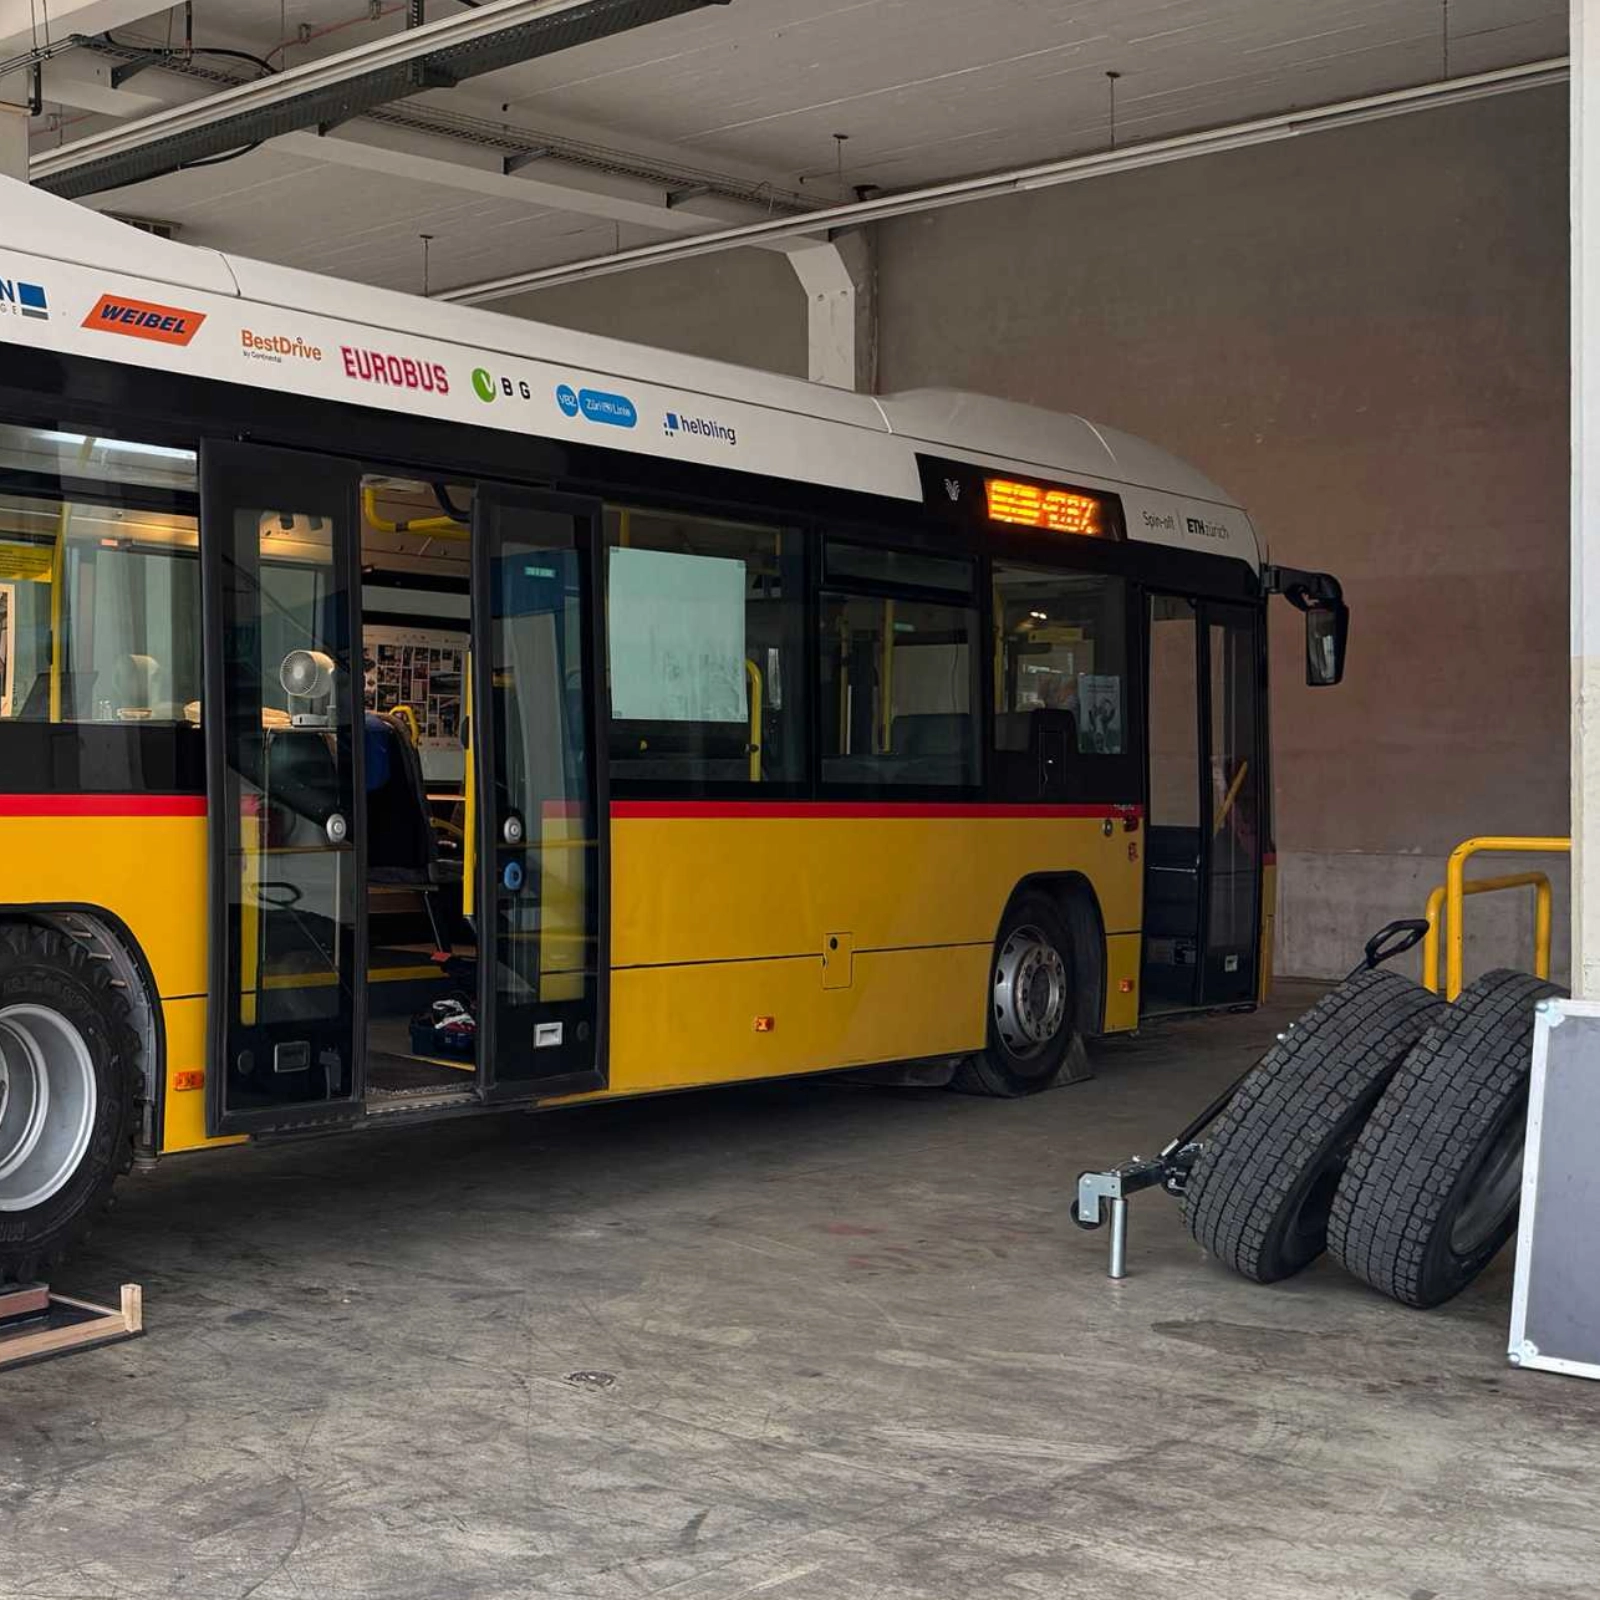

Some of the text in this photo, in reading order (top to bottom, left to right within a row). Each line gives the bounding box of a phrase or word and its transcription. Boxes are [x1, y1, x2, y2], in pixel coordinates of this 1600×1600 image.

[101, 303, 188, 334] WEIBEL
[241, 329, 322, 361] BestDrive
[340, 346, 450, 395] EUROBUS
[680, 415, 737, 446] helbling
